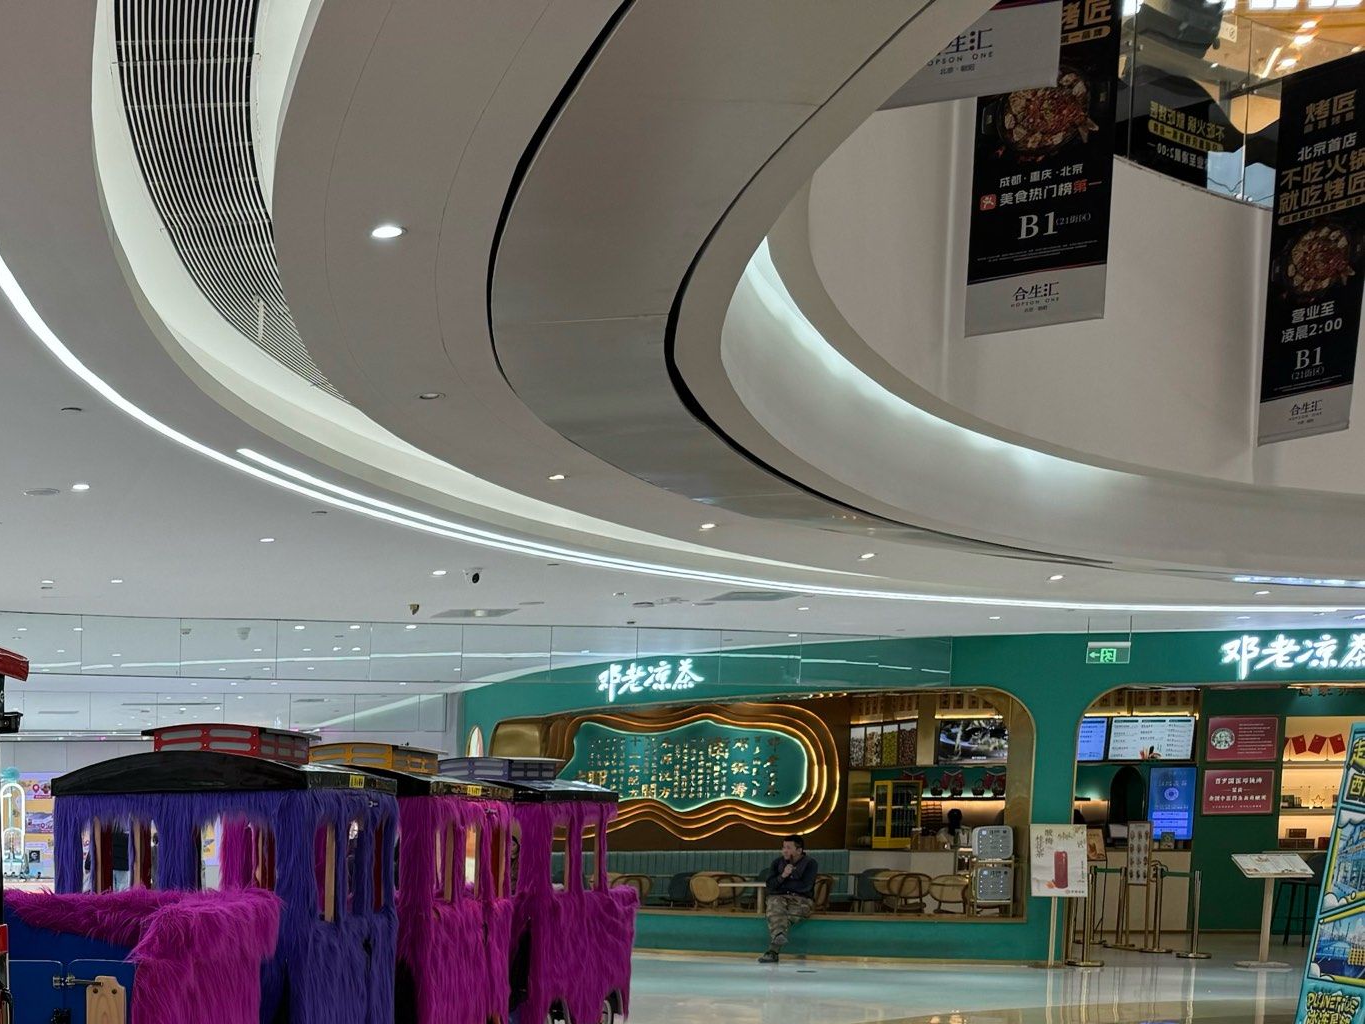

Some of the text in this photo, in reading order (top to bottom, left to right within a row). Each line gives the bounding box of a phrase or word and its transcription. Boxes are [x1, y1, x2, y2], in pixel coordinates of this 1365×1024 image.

[936, 28, 993, 56] 生汇
[1297, 131, 1357, 162] 北京首店
[999, 178, 1103, 207] 美食热门榜第一
[1017, 211, 1059, 241] B1
[1012, 281, 1060, 302] 合生汇
[1291, 300, 1336, 324] 营业至
[1281, 318, 1343, 343] 凌晨2:00
[1294, 346, 1323, 370] B1
[597, 657, 705, 703] 邓老凉茶
